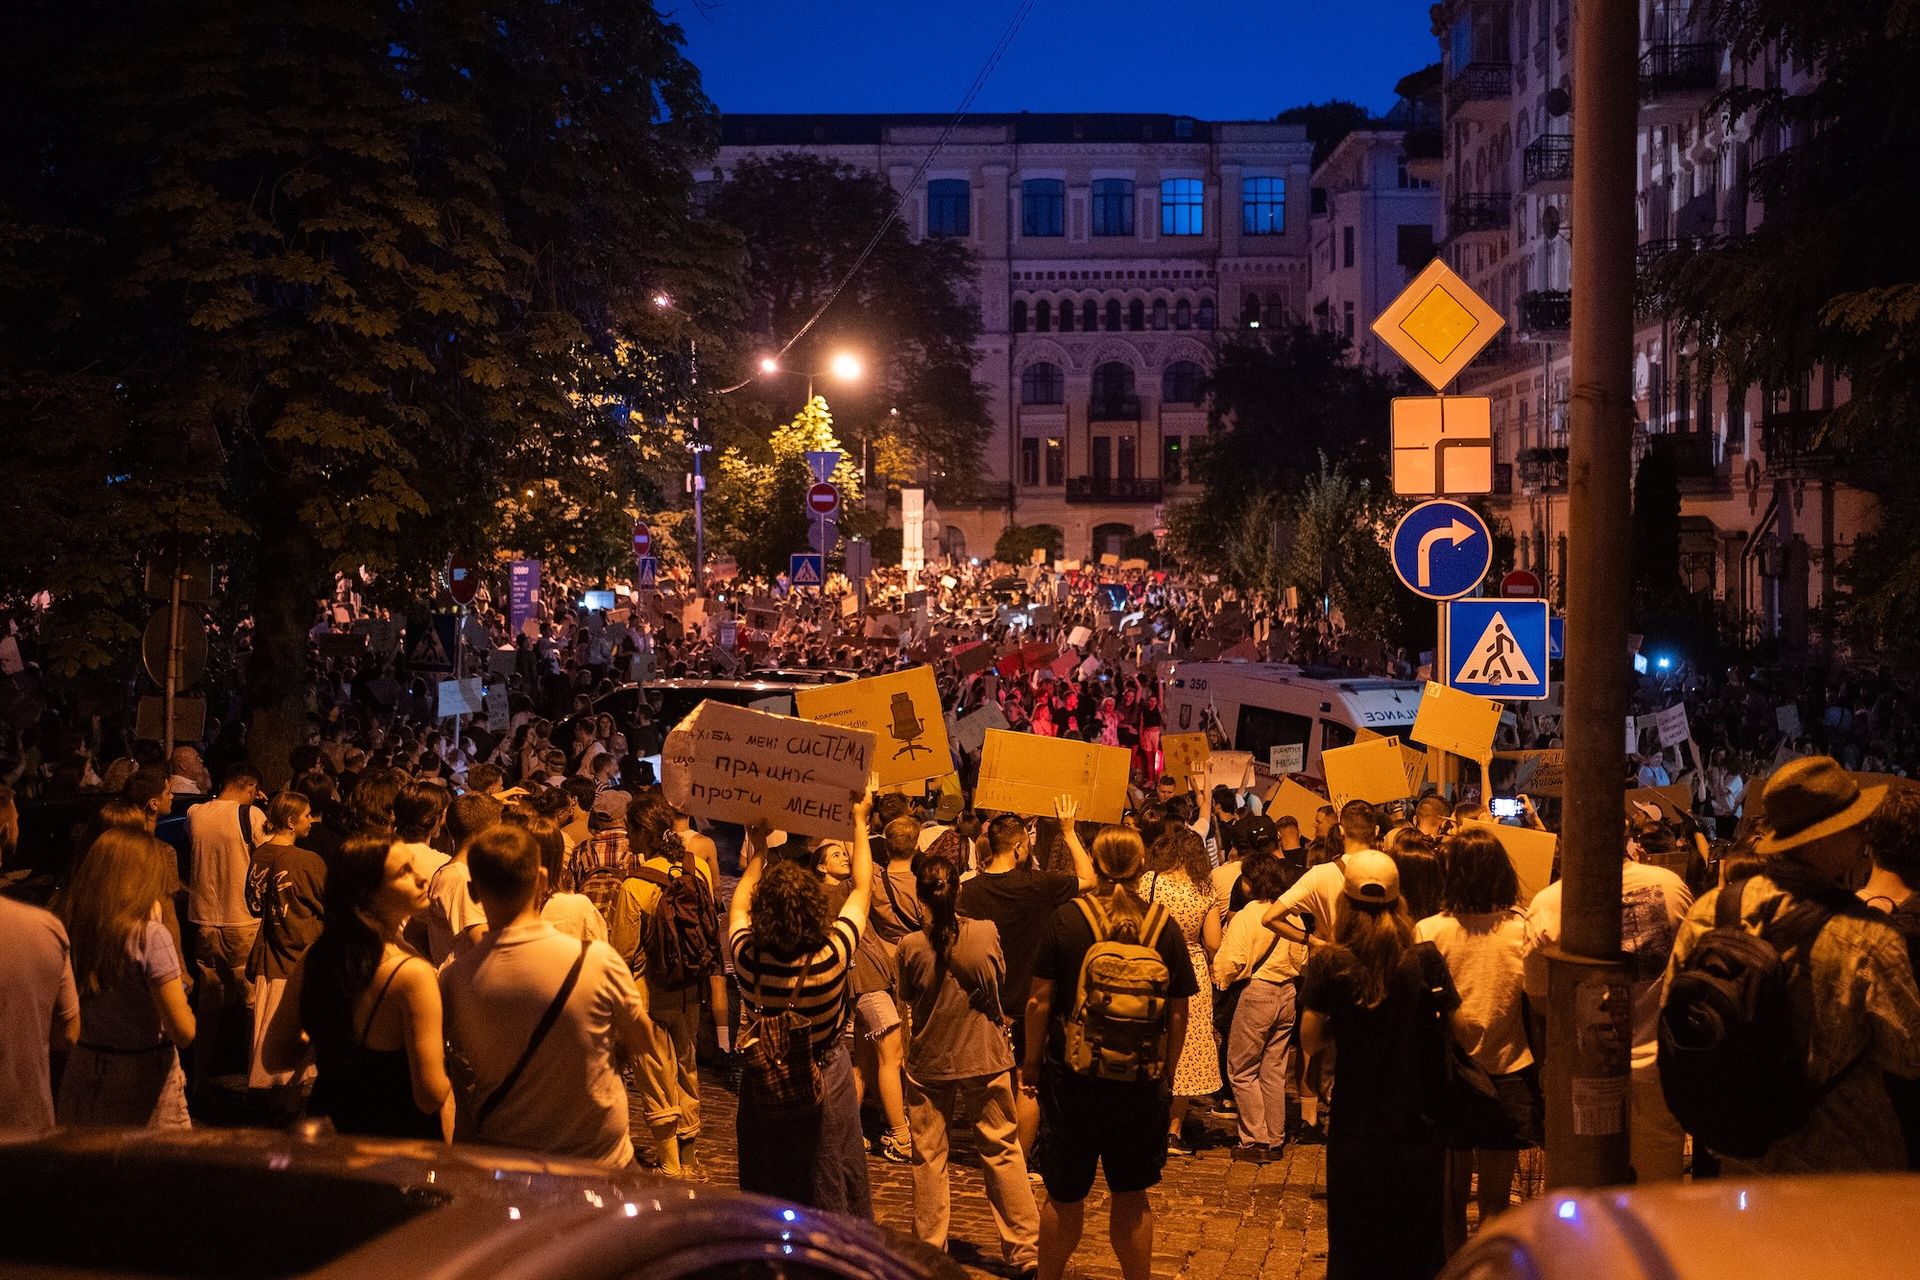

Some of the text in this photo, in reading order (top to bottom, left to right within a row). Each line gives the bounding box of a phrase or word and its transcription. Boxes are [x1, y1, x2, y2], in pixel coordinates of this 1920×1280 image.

[1190, 678, 1207, 690] 350
[786, 734, 864, 771] СИСТЕМА
[691, 782, 762, 806] ПРОТИ
